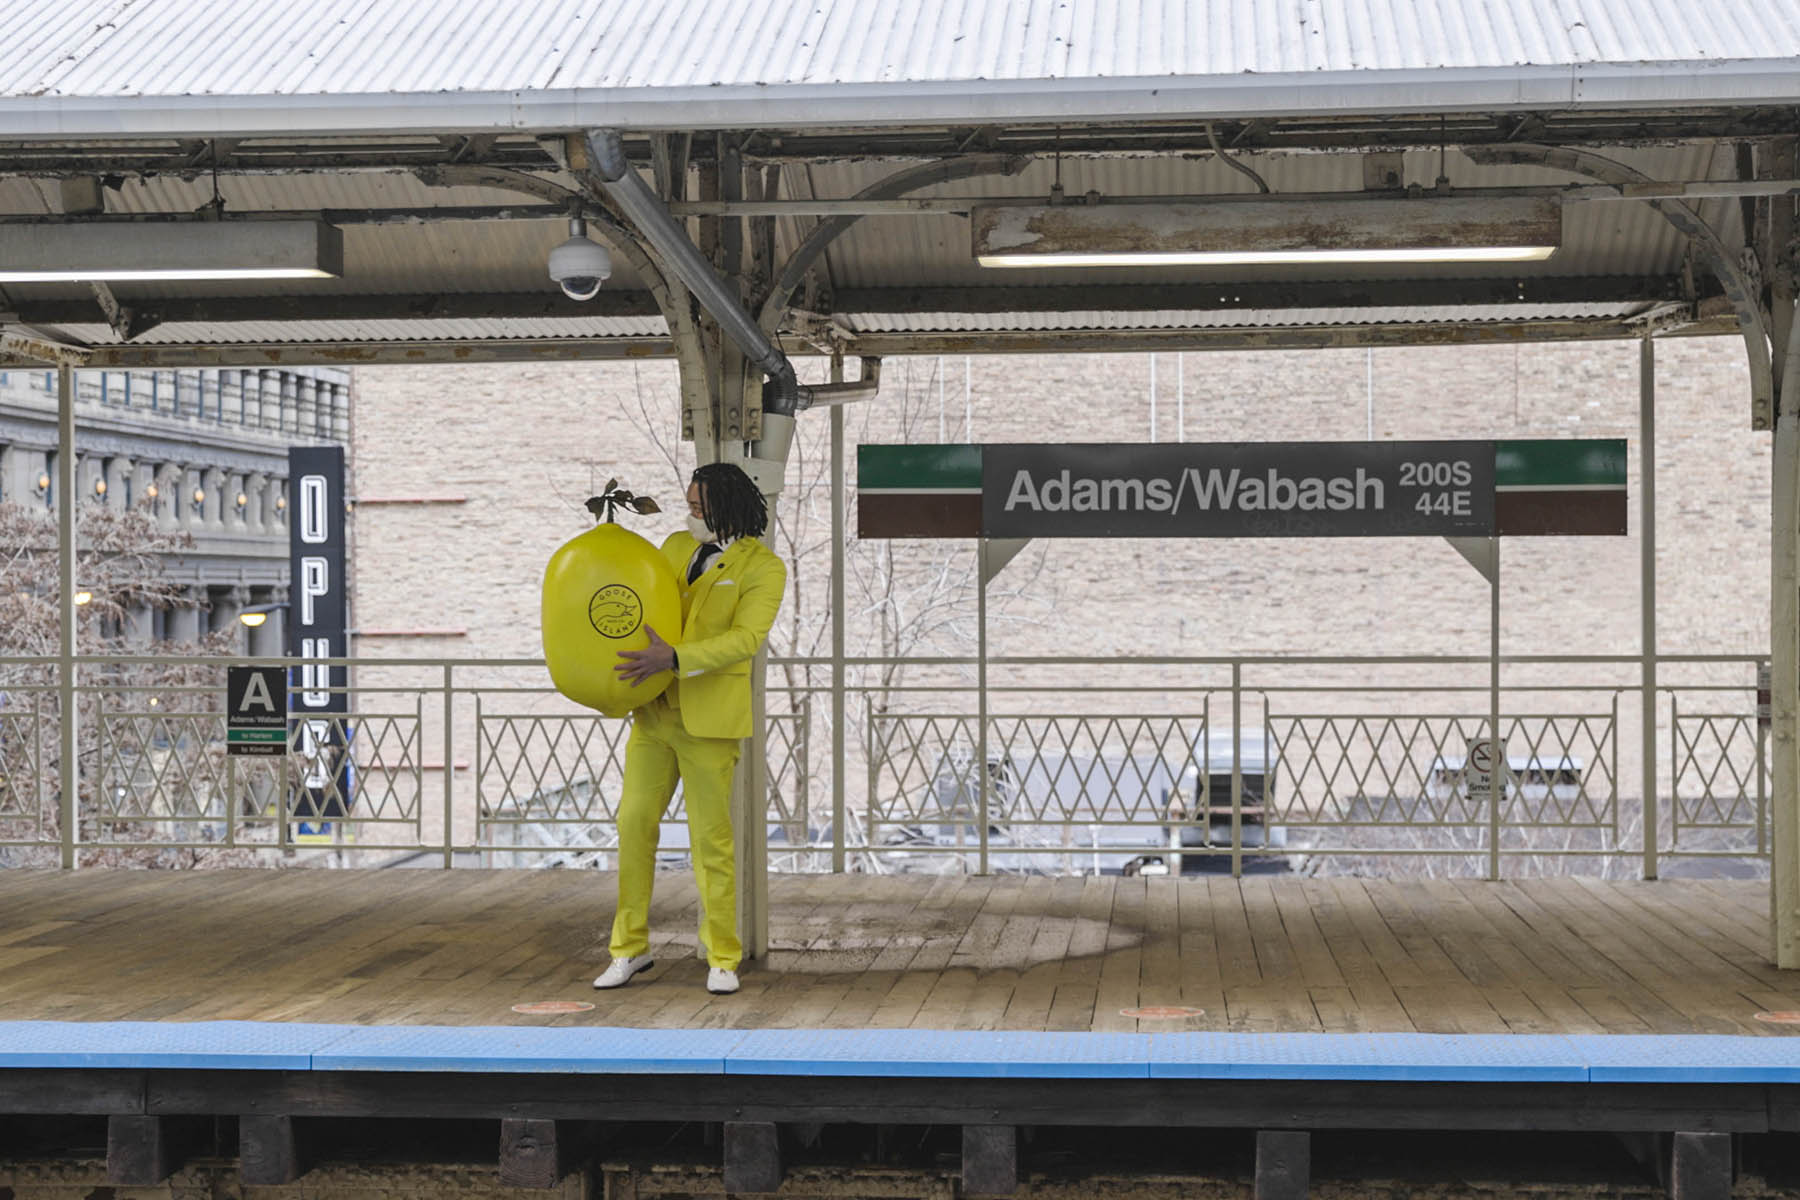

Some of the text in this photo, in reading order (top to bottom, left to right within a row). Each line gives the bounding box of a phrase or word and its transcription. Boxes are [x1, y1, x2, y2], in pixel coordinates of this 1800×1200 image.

[1399, 461, 1472, 487] 200S
[1004, 467, 1385, 516] Adams/Wabash
[1415, 490, 1472, 516] 44E
[599, 589, 633, 600] GOOSE
[599, 620, 634, 634] ISLAND
[239, 672, 276, 712] A
[1469, 783, 1506, 792] Smog
